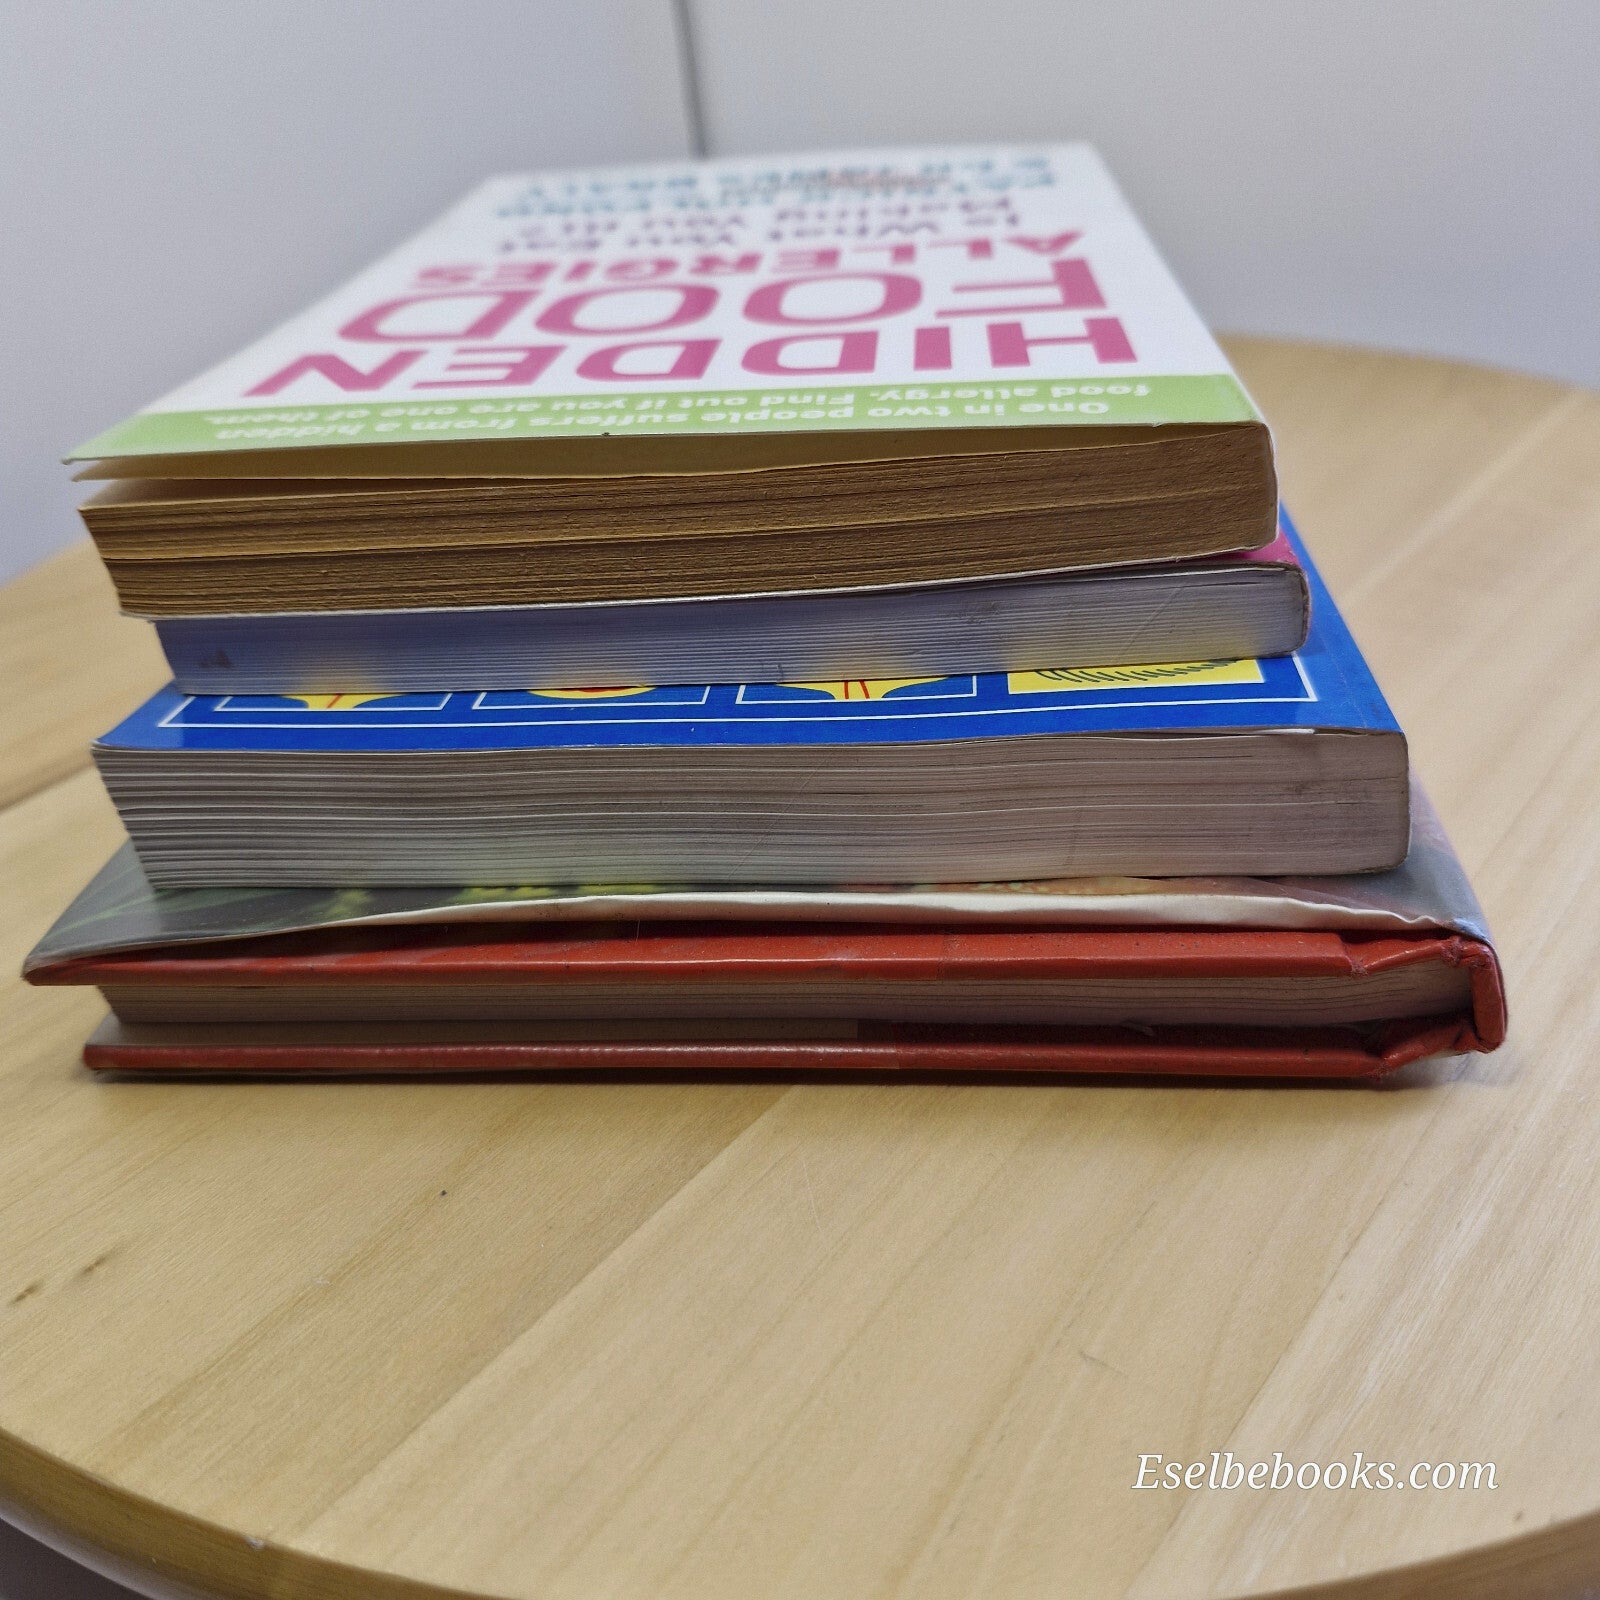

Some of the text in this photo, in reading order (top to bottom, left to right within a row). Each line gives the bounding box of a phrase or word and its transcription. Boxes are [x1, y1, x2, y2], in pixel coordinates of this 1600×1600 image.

[766, 220, 941, 244] What
[414, 230, 1081, 288] ALLERGIES
[336, 257, 1108, 343] FOOD
[241, 315, 1139, 398] HIDDEN
[869, 387, 1039, 402] allergy.
[1051, 384, 1150, 398] food
[551, 398, 628, 411] you
[634, 398, 668, 411] if
[677, 396, 749, 409] out
[759, 393, 855, 407] Find
[324, 408, 371, 422] of
[380, 405, 459, 418] one
[469, 402, 542, 414] are
[216, 401, 1110, 440] One in two people suffers from a hidden
